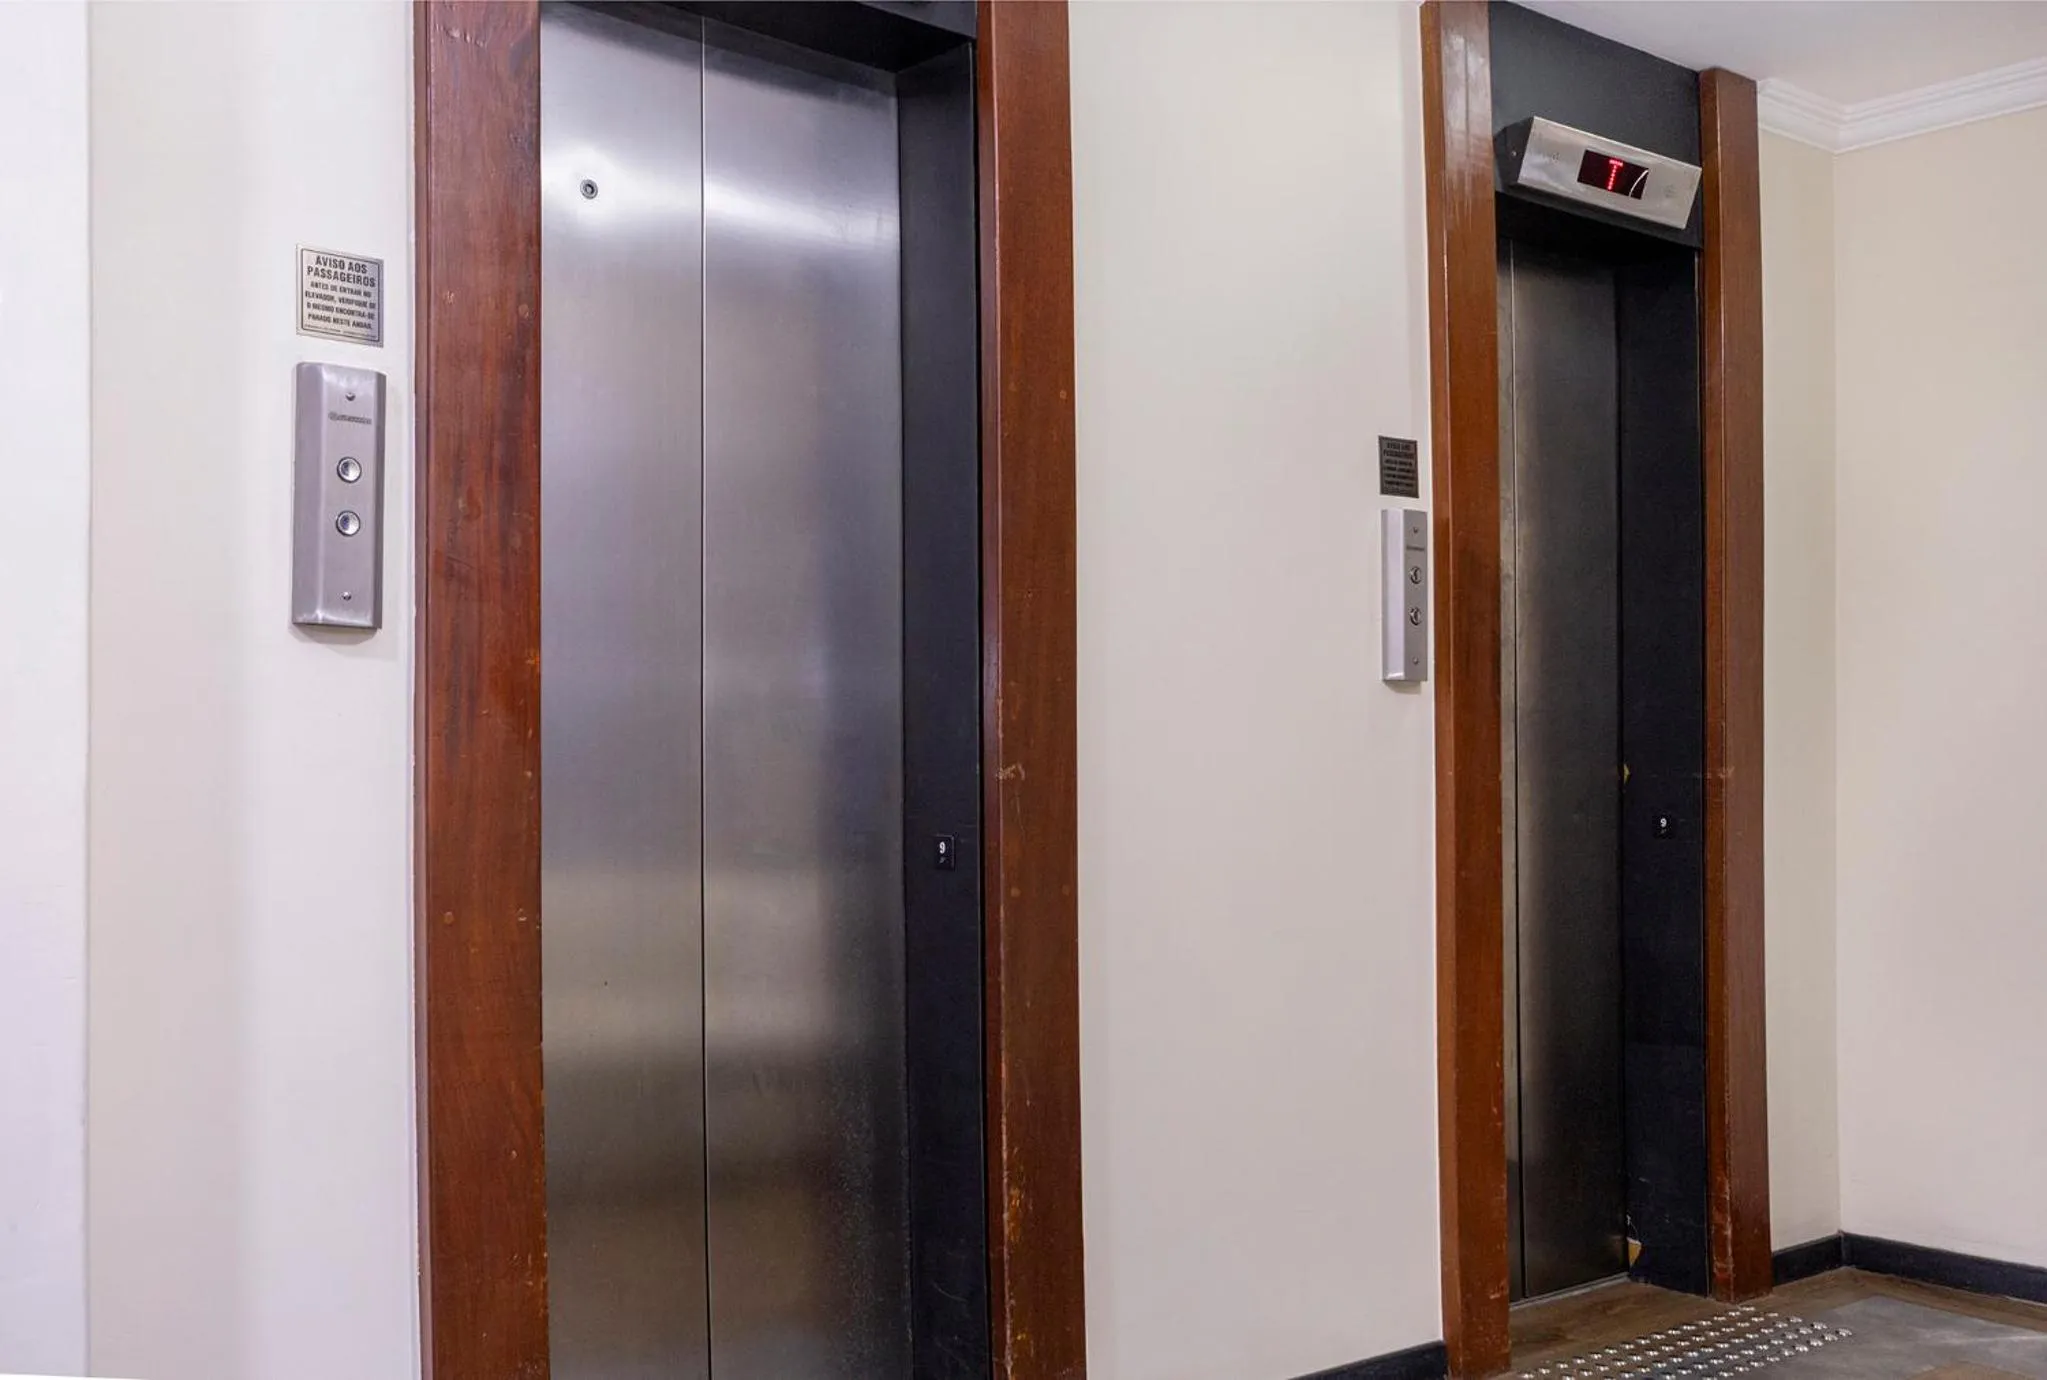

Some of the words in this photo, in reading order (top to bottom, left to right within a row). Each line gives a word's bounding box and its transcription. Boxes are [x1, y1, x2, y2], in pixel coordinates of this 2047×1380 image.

[1607, 158, 1624, 191] T
[315, 255, 345, 269] AVISO
[347, 262, 368, 274] AOS
[307, 266, 376, 287] PASSAGEIROS
[339, 286, 362, 296] ENTRAR
[1660, 817, 1667, 828] 9
[939, 841, 946, 854] 9
